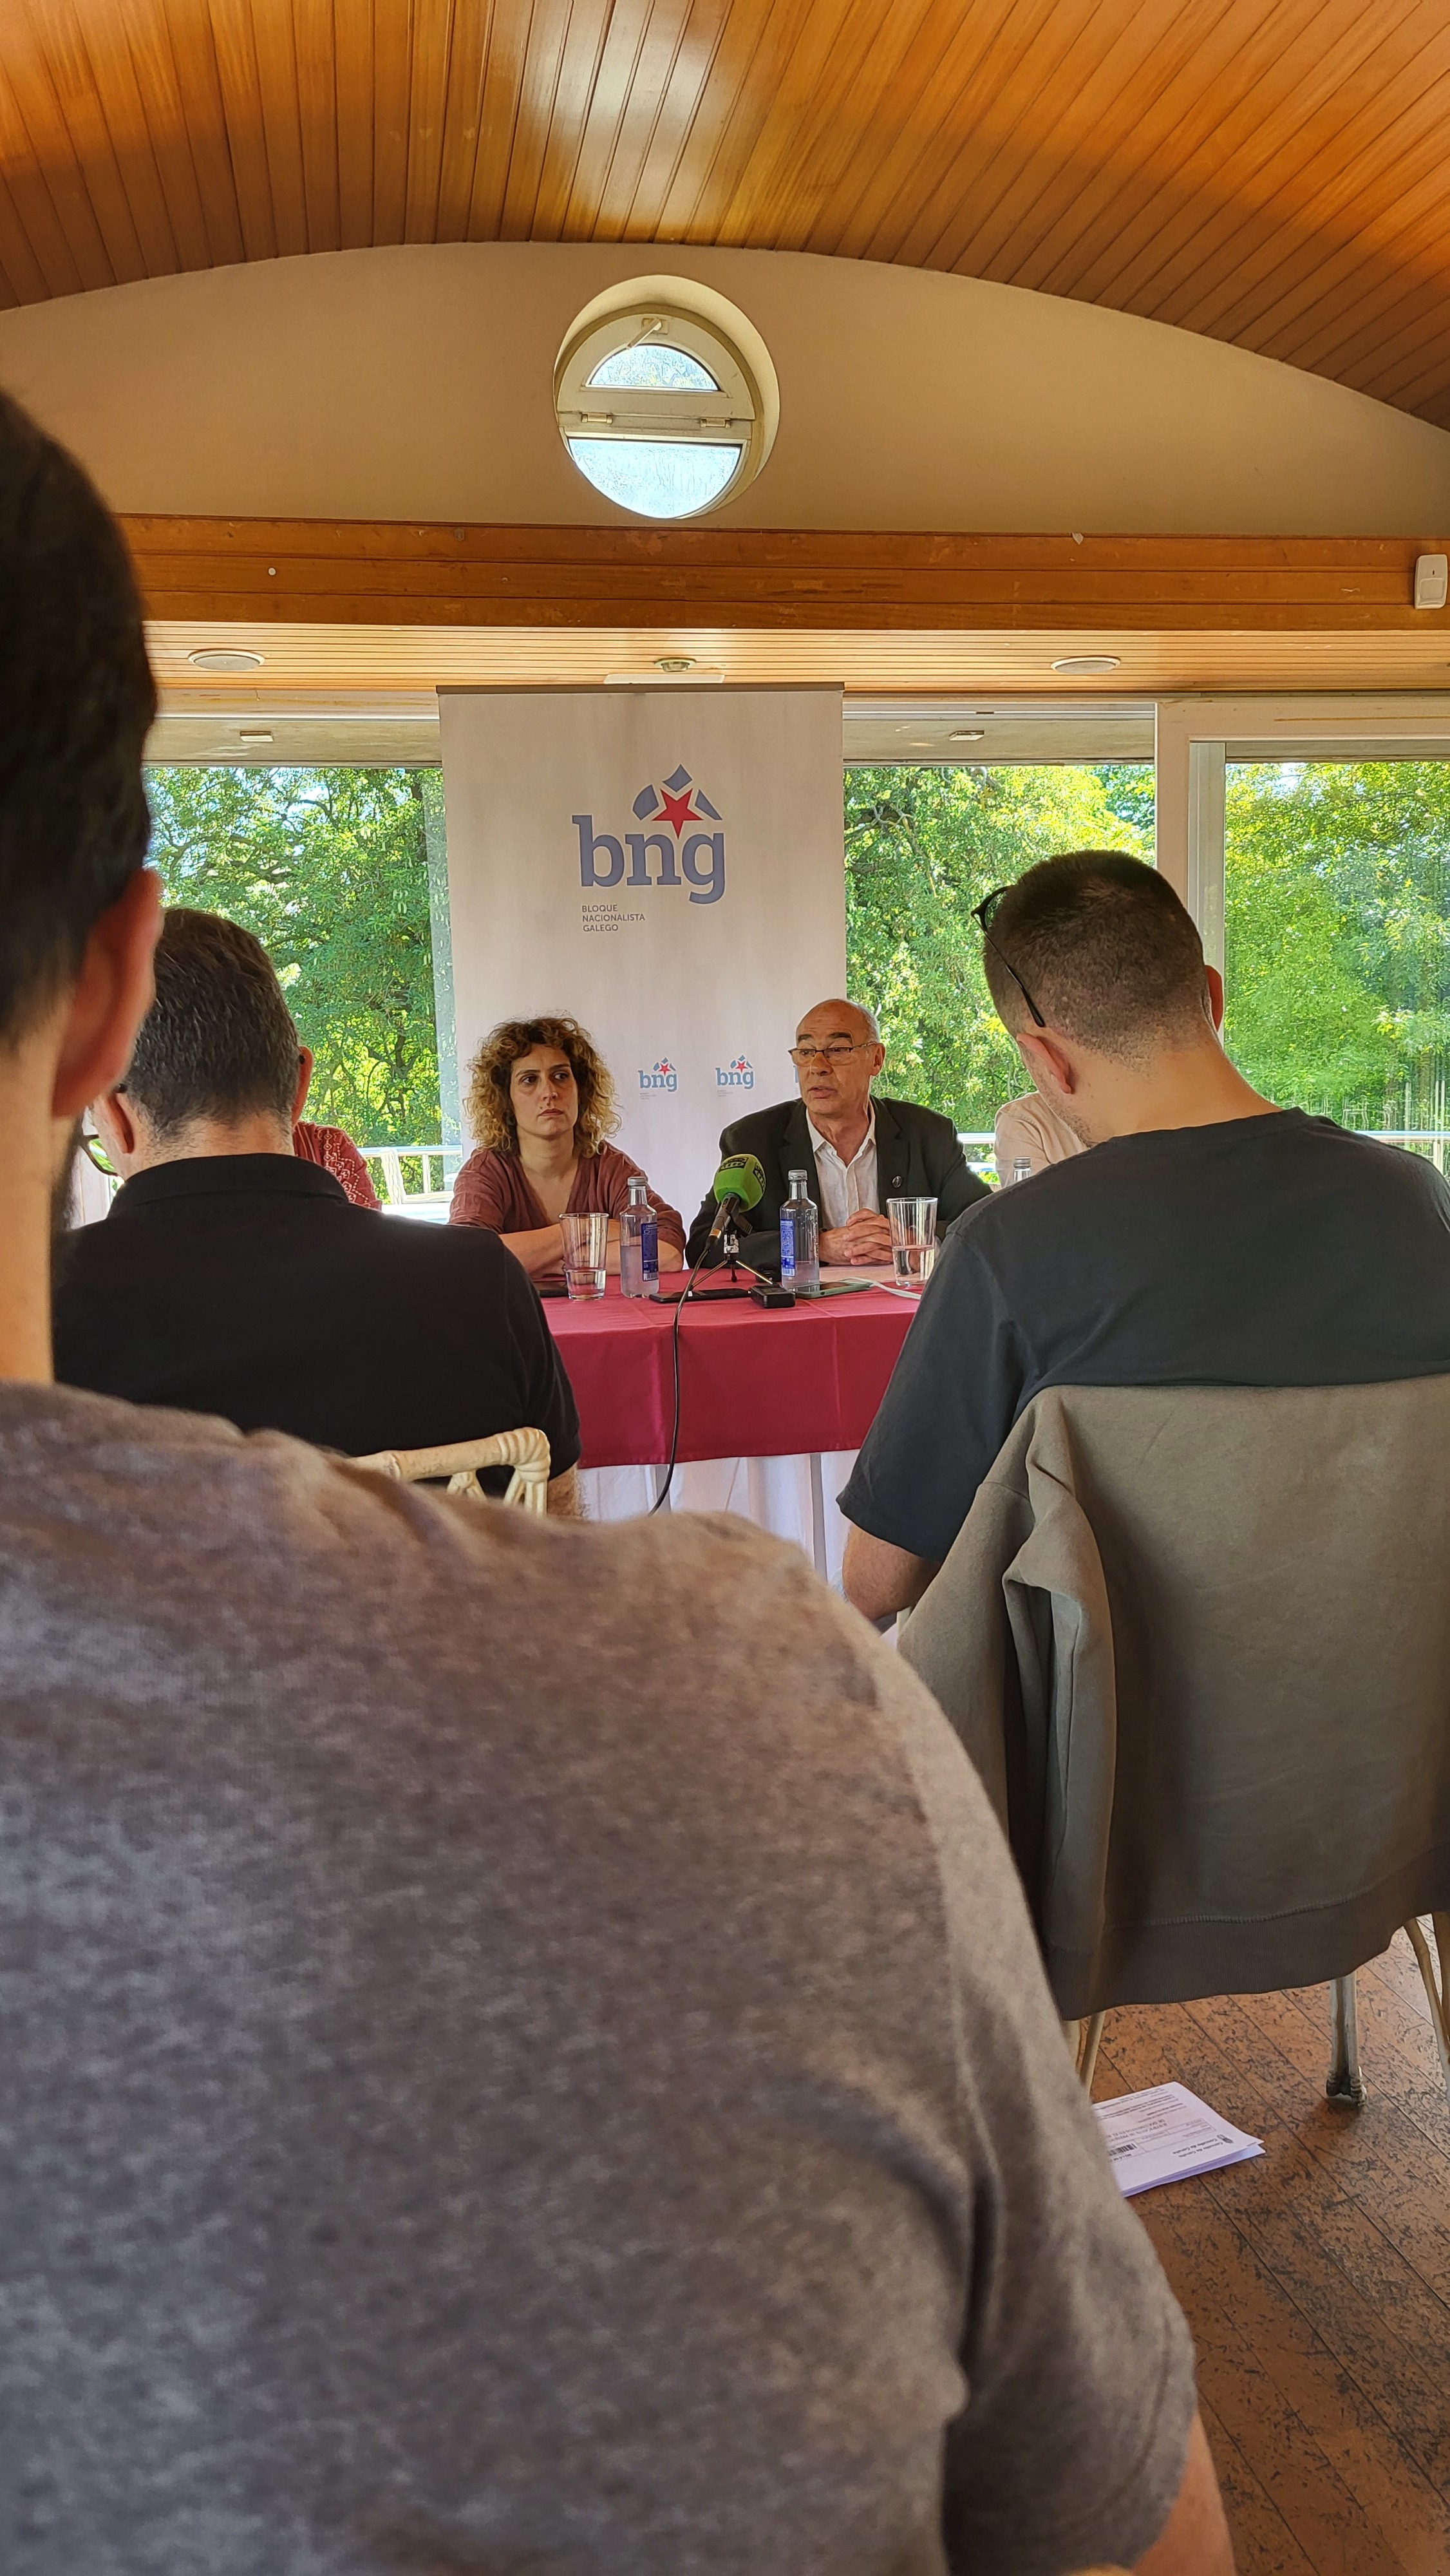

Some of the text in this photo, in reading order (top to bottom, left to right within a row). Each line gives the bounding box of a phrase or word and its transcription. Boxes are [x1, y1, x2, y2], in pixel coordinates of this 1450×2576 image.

[572, 814, 726, 904] bng
[581, 904, 618, 913] BLOQUE
[582, 913, 645, 922] NACIONALISTA
[583, 923, 619, 932] GALEGO
[638, 1070, 677, 1092] bng
[715, 1067, 754, 1090] bng
